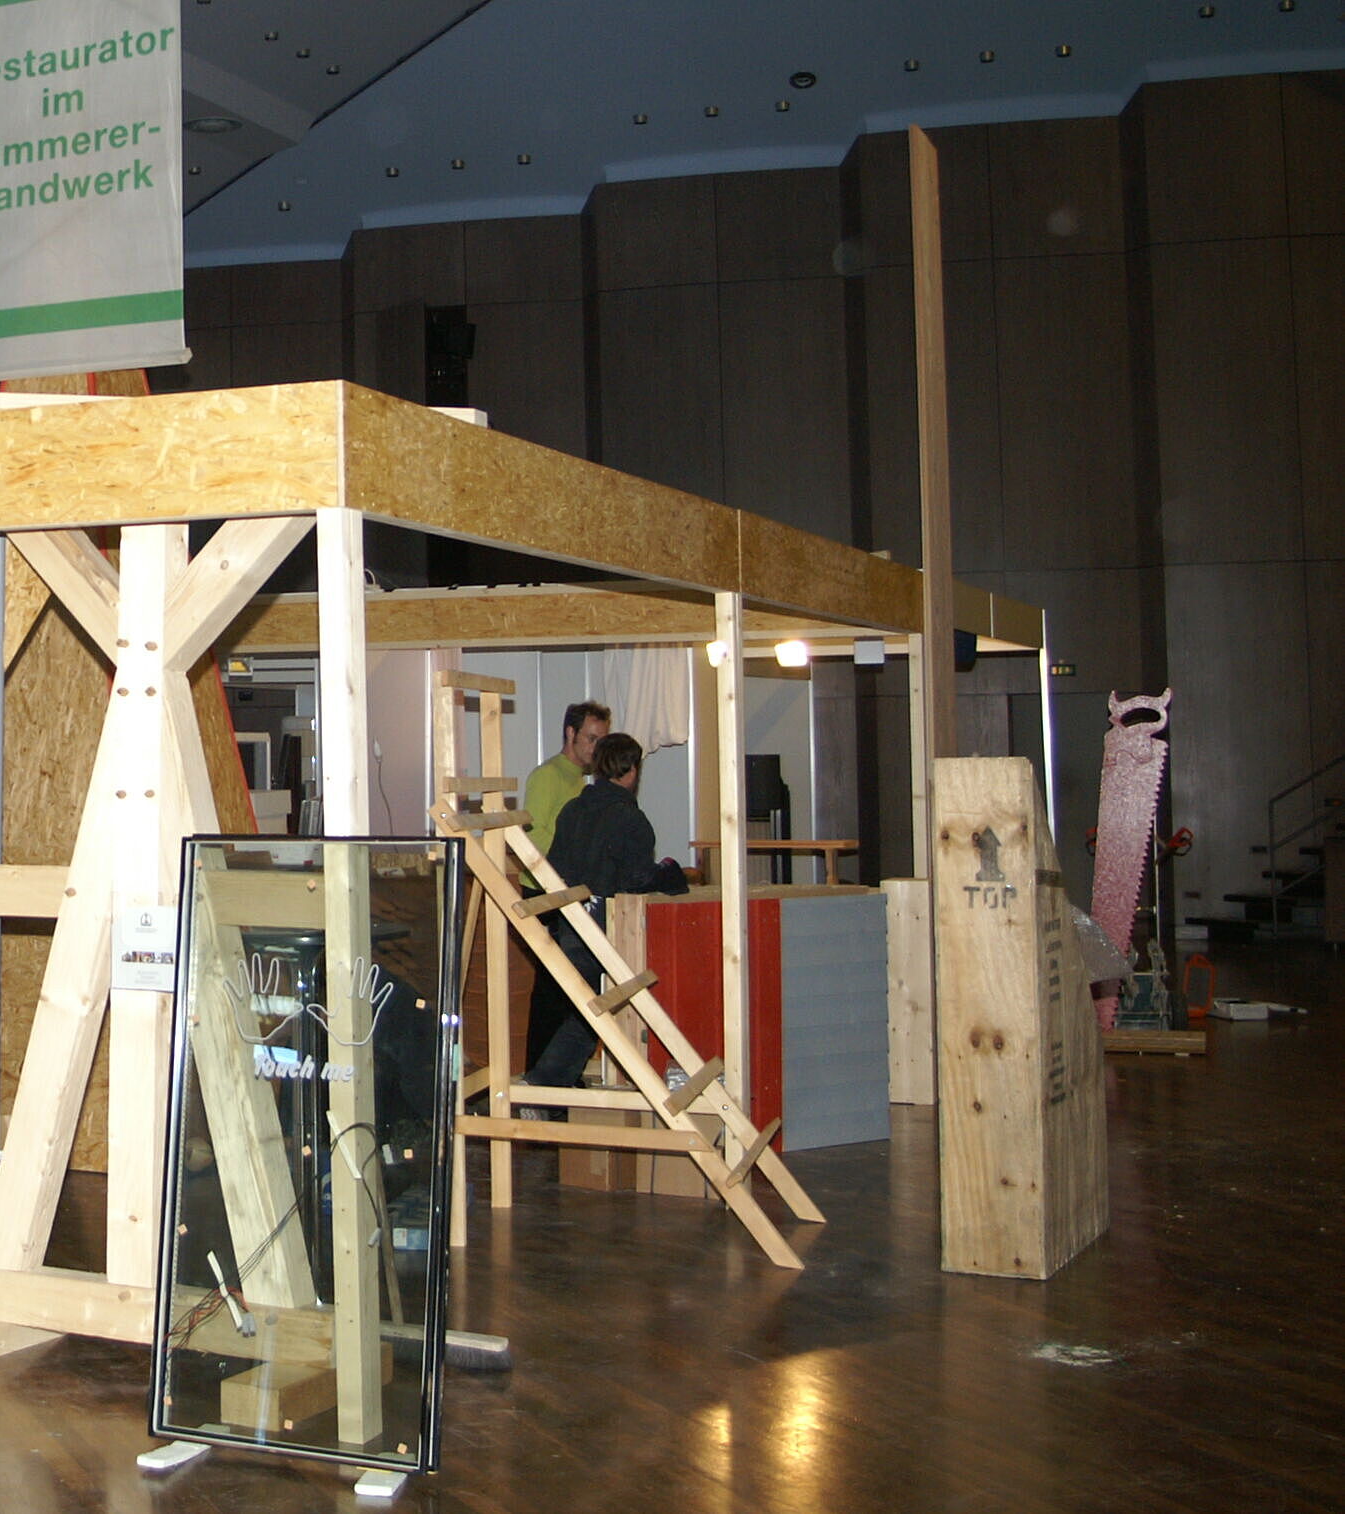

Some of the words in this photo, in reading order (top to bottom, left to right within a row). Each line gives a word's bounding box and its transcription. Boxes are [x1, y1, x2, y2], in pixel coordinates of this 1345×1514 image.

[42, 88, 84, 117] im
[963, 886, 1017, 909] TOP
[255, 1055, 315, 1080] Touch
[320, 1061, 354, 1080] me
